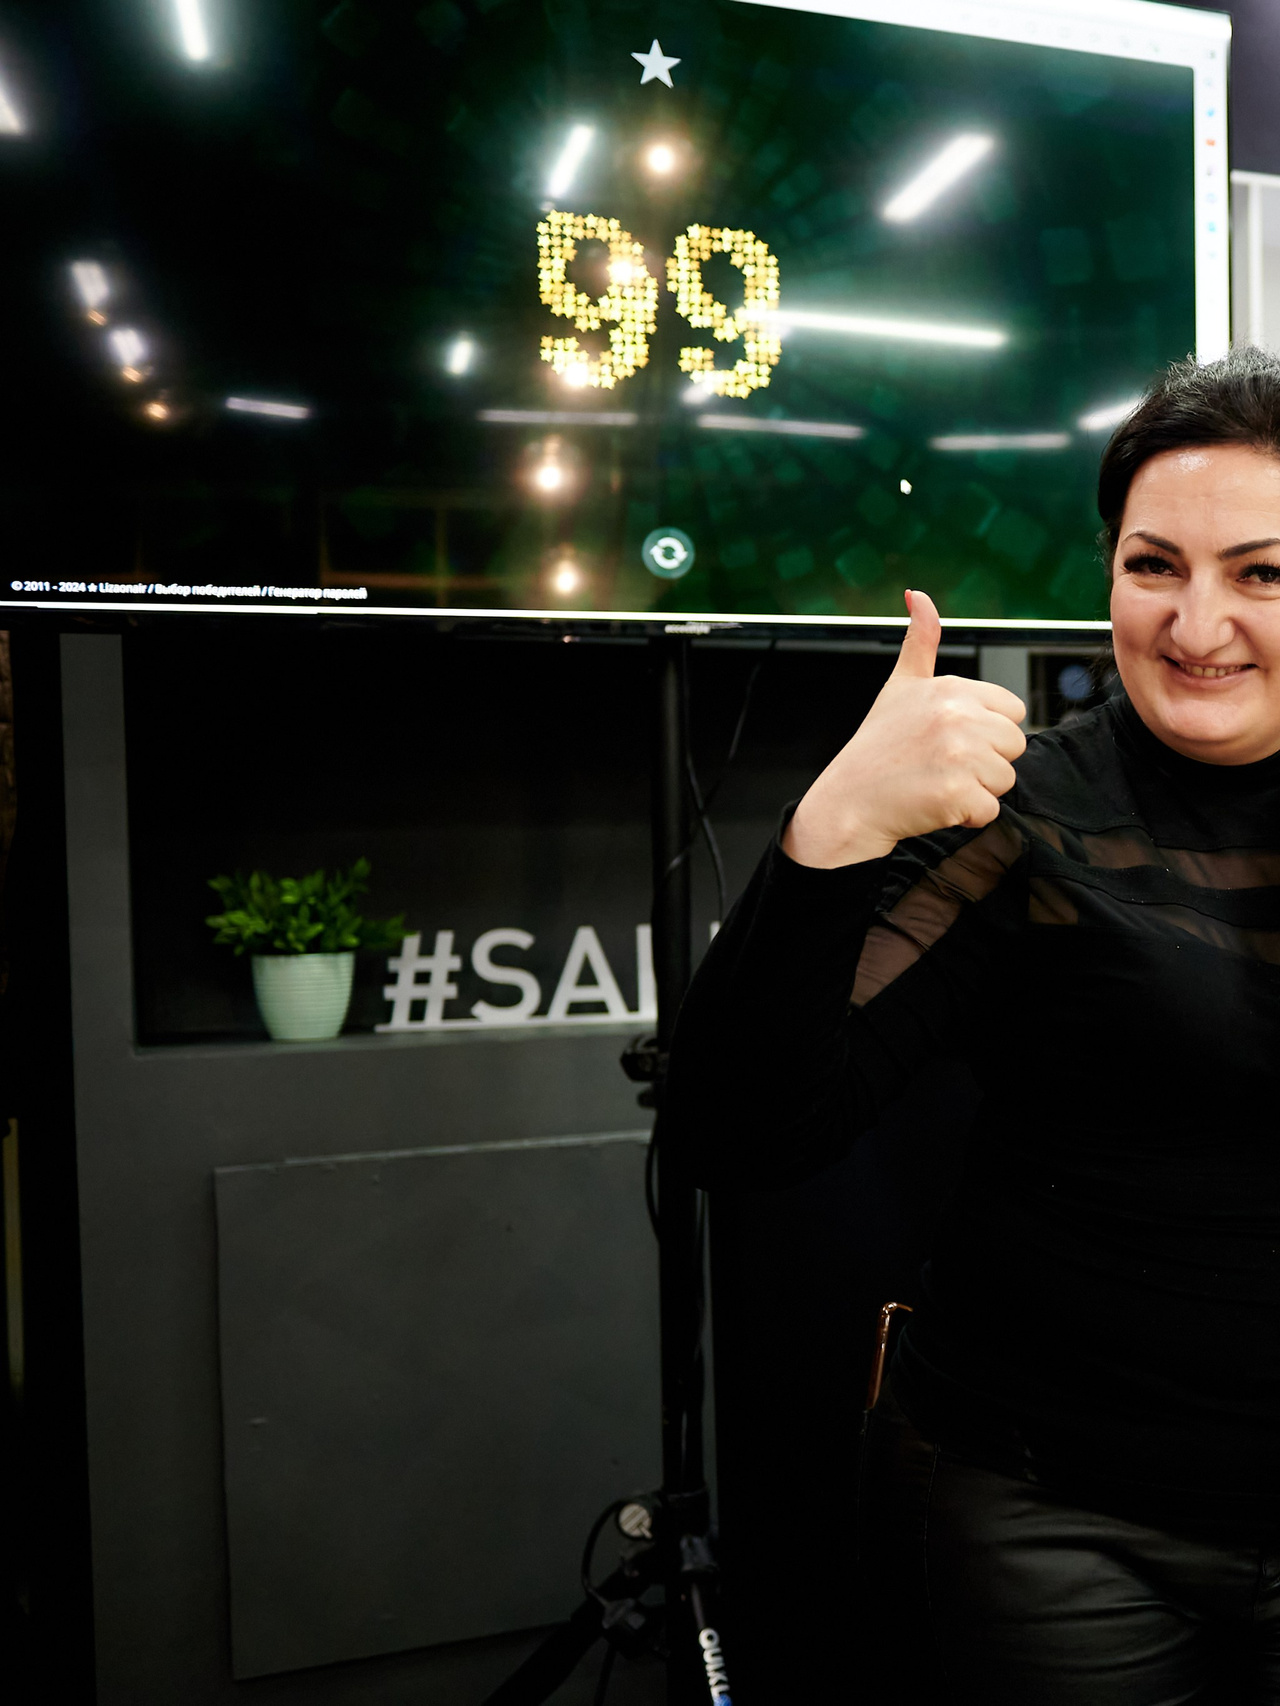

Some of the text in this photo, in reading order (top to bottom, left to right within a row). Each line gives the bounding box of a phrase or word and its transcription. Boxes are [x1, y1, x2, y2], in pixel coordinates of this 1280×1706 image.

[536, 209, 782, 399] 99
[24, 581, 50, 592] 2011
[58, 582, 86, 593] 2024
[154, 583, 191, 597] Выбор
